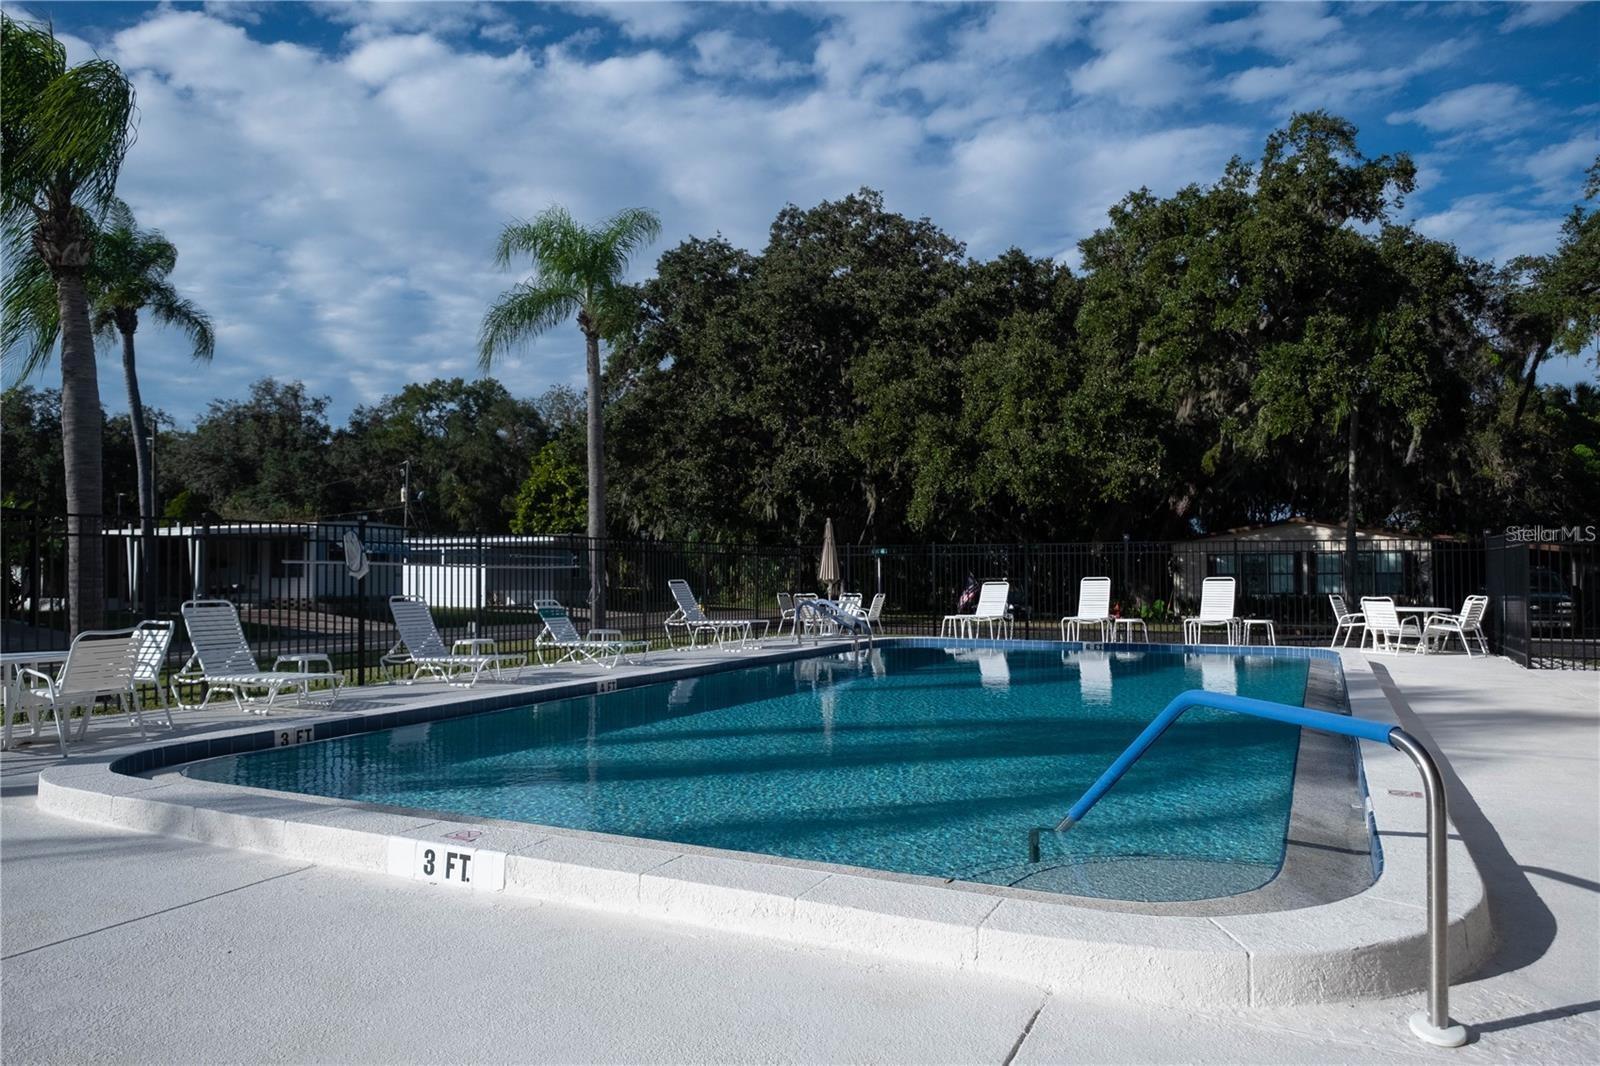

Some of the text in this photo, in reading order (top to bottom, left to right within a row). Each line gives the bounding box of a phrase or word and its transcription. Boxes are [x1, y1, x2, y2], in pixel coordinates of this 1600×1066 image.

[280, 728, 312, 746] 3 FT
[423, 849, 471, 883] 3 FT.
